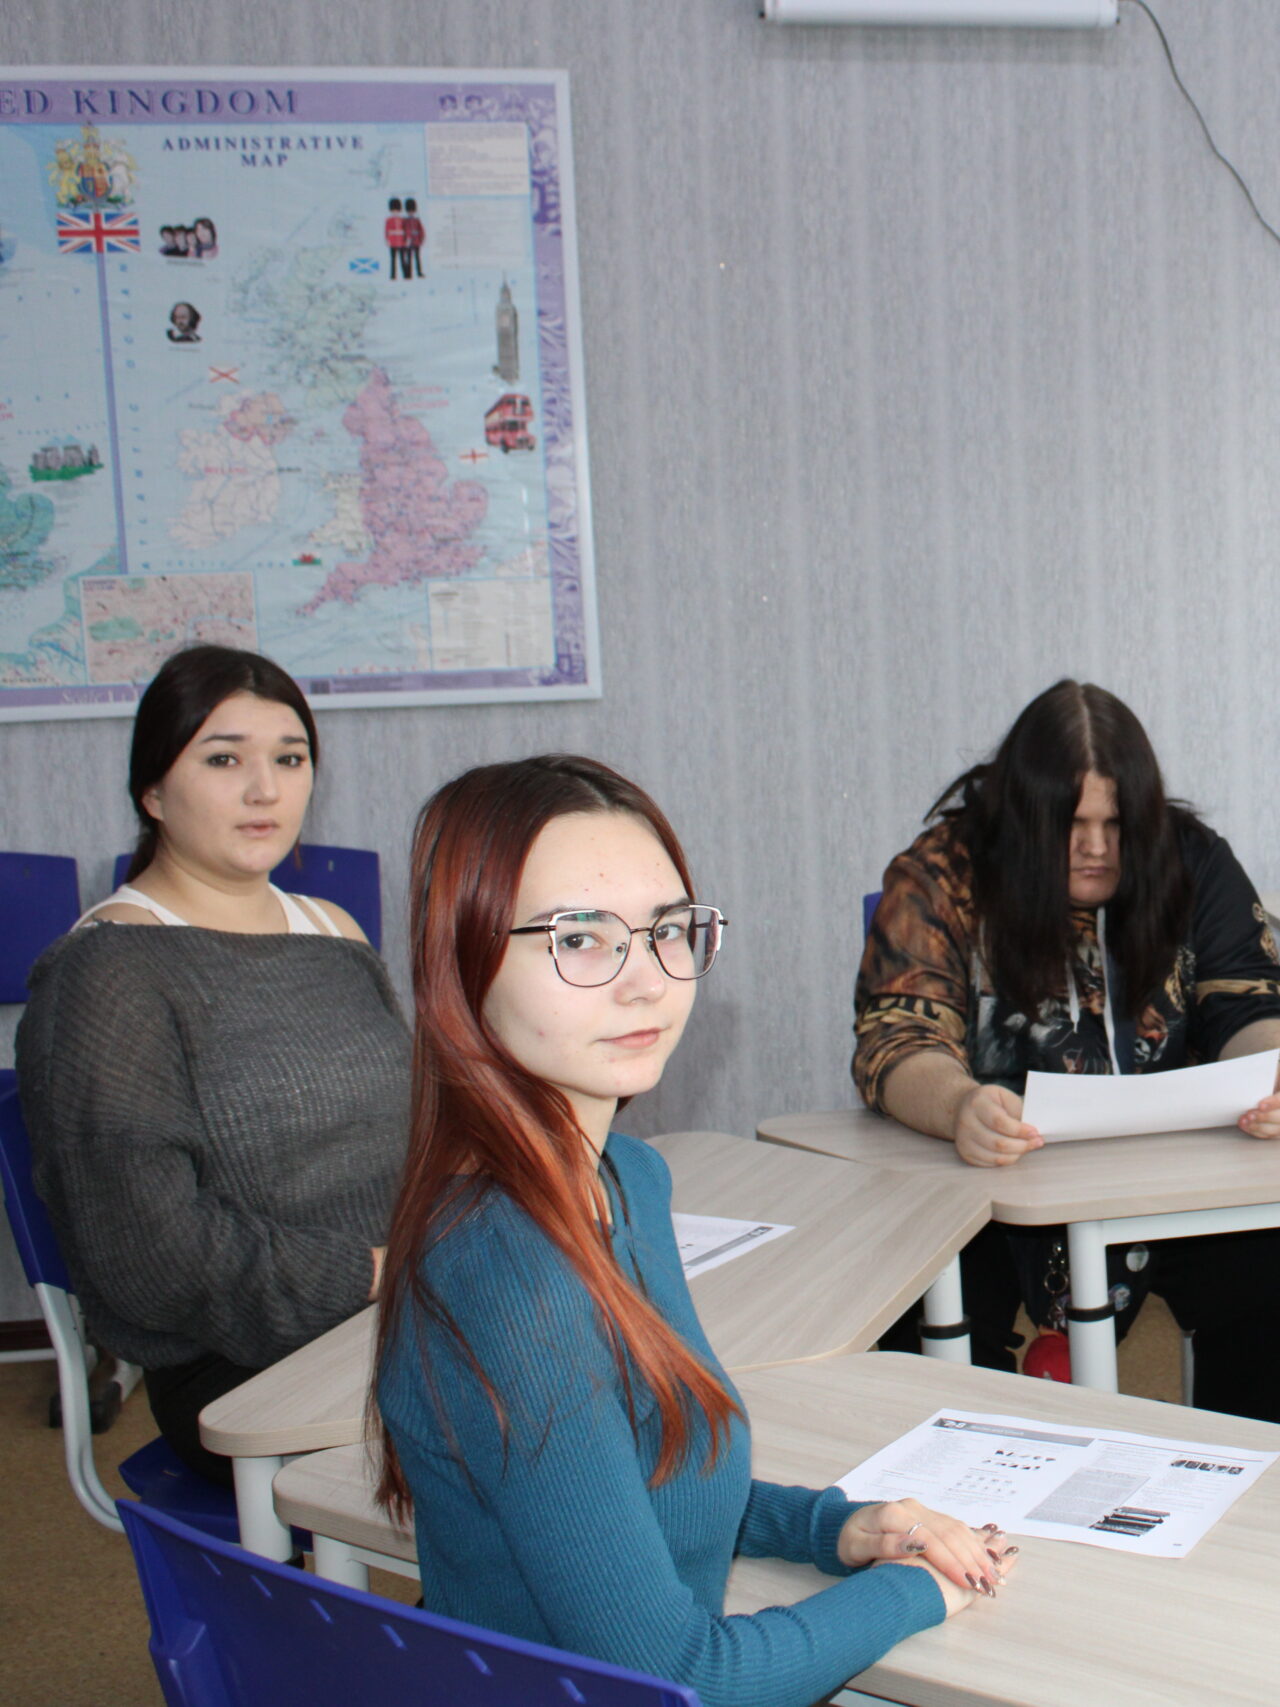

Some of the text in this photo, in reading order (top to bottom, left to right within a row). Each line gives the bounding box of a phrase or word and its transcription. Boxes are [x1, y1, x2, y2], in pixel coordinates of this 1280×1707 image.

[73, 89, 298, 115] KINGDOM
[162, 136, 364, 151] ADMINISTRATIVE
[240, 154, 289, 167] MAP
